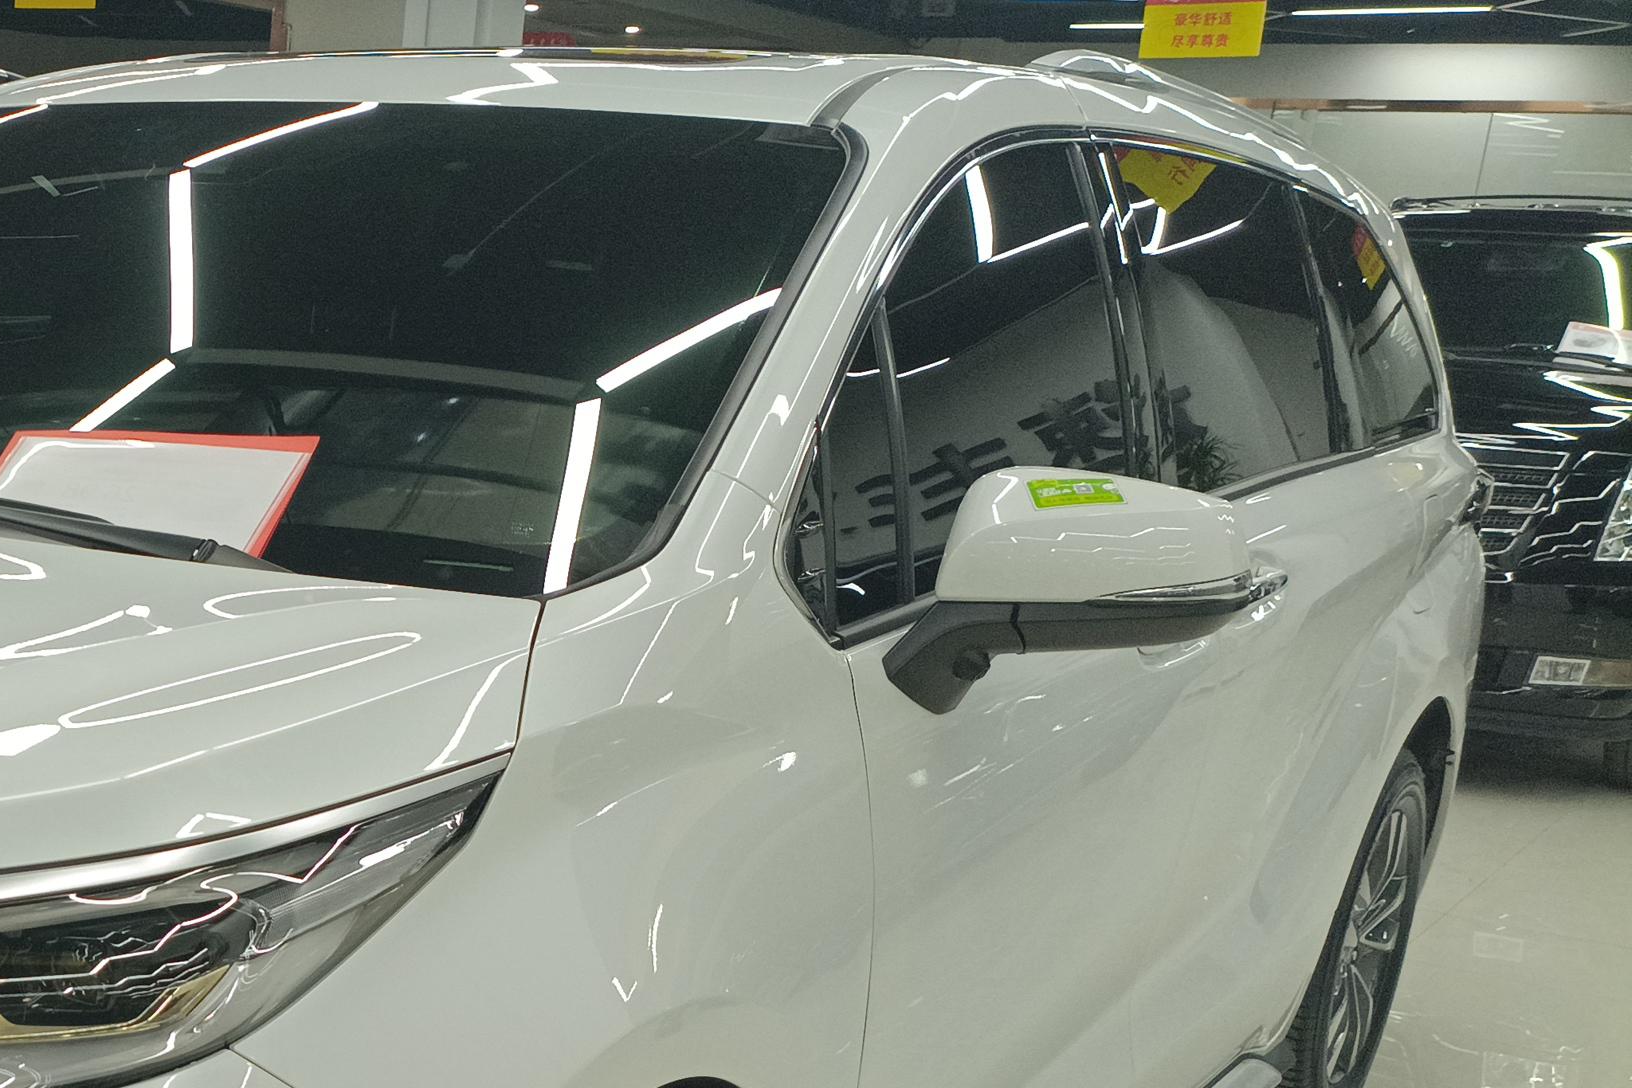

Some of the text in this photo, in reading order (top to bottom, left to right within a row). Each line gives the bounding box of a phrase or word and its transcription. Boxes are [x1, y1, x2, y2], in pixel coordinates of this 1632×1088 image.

[1175, 12, 1232, 26] 豪华舒适
[1171, 34, 1229, 48] 尽享尊贵
